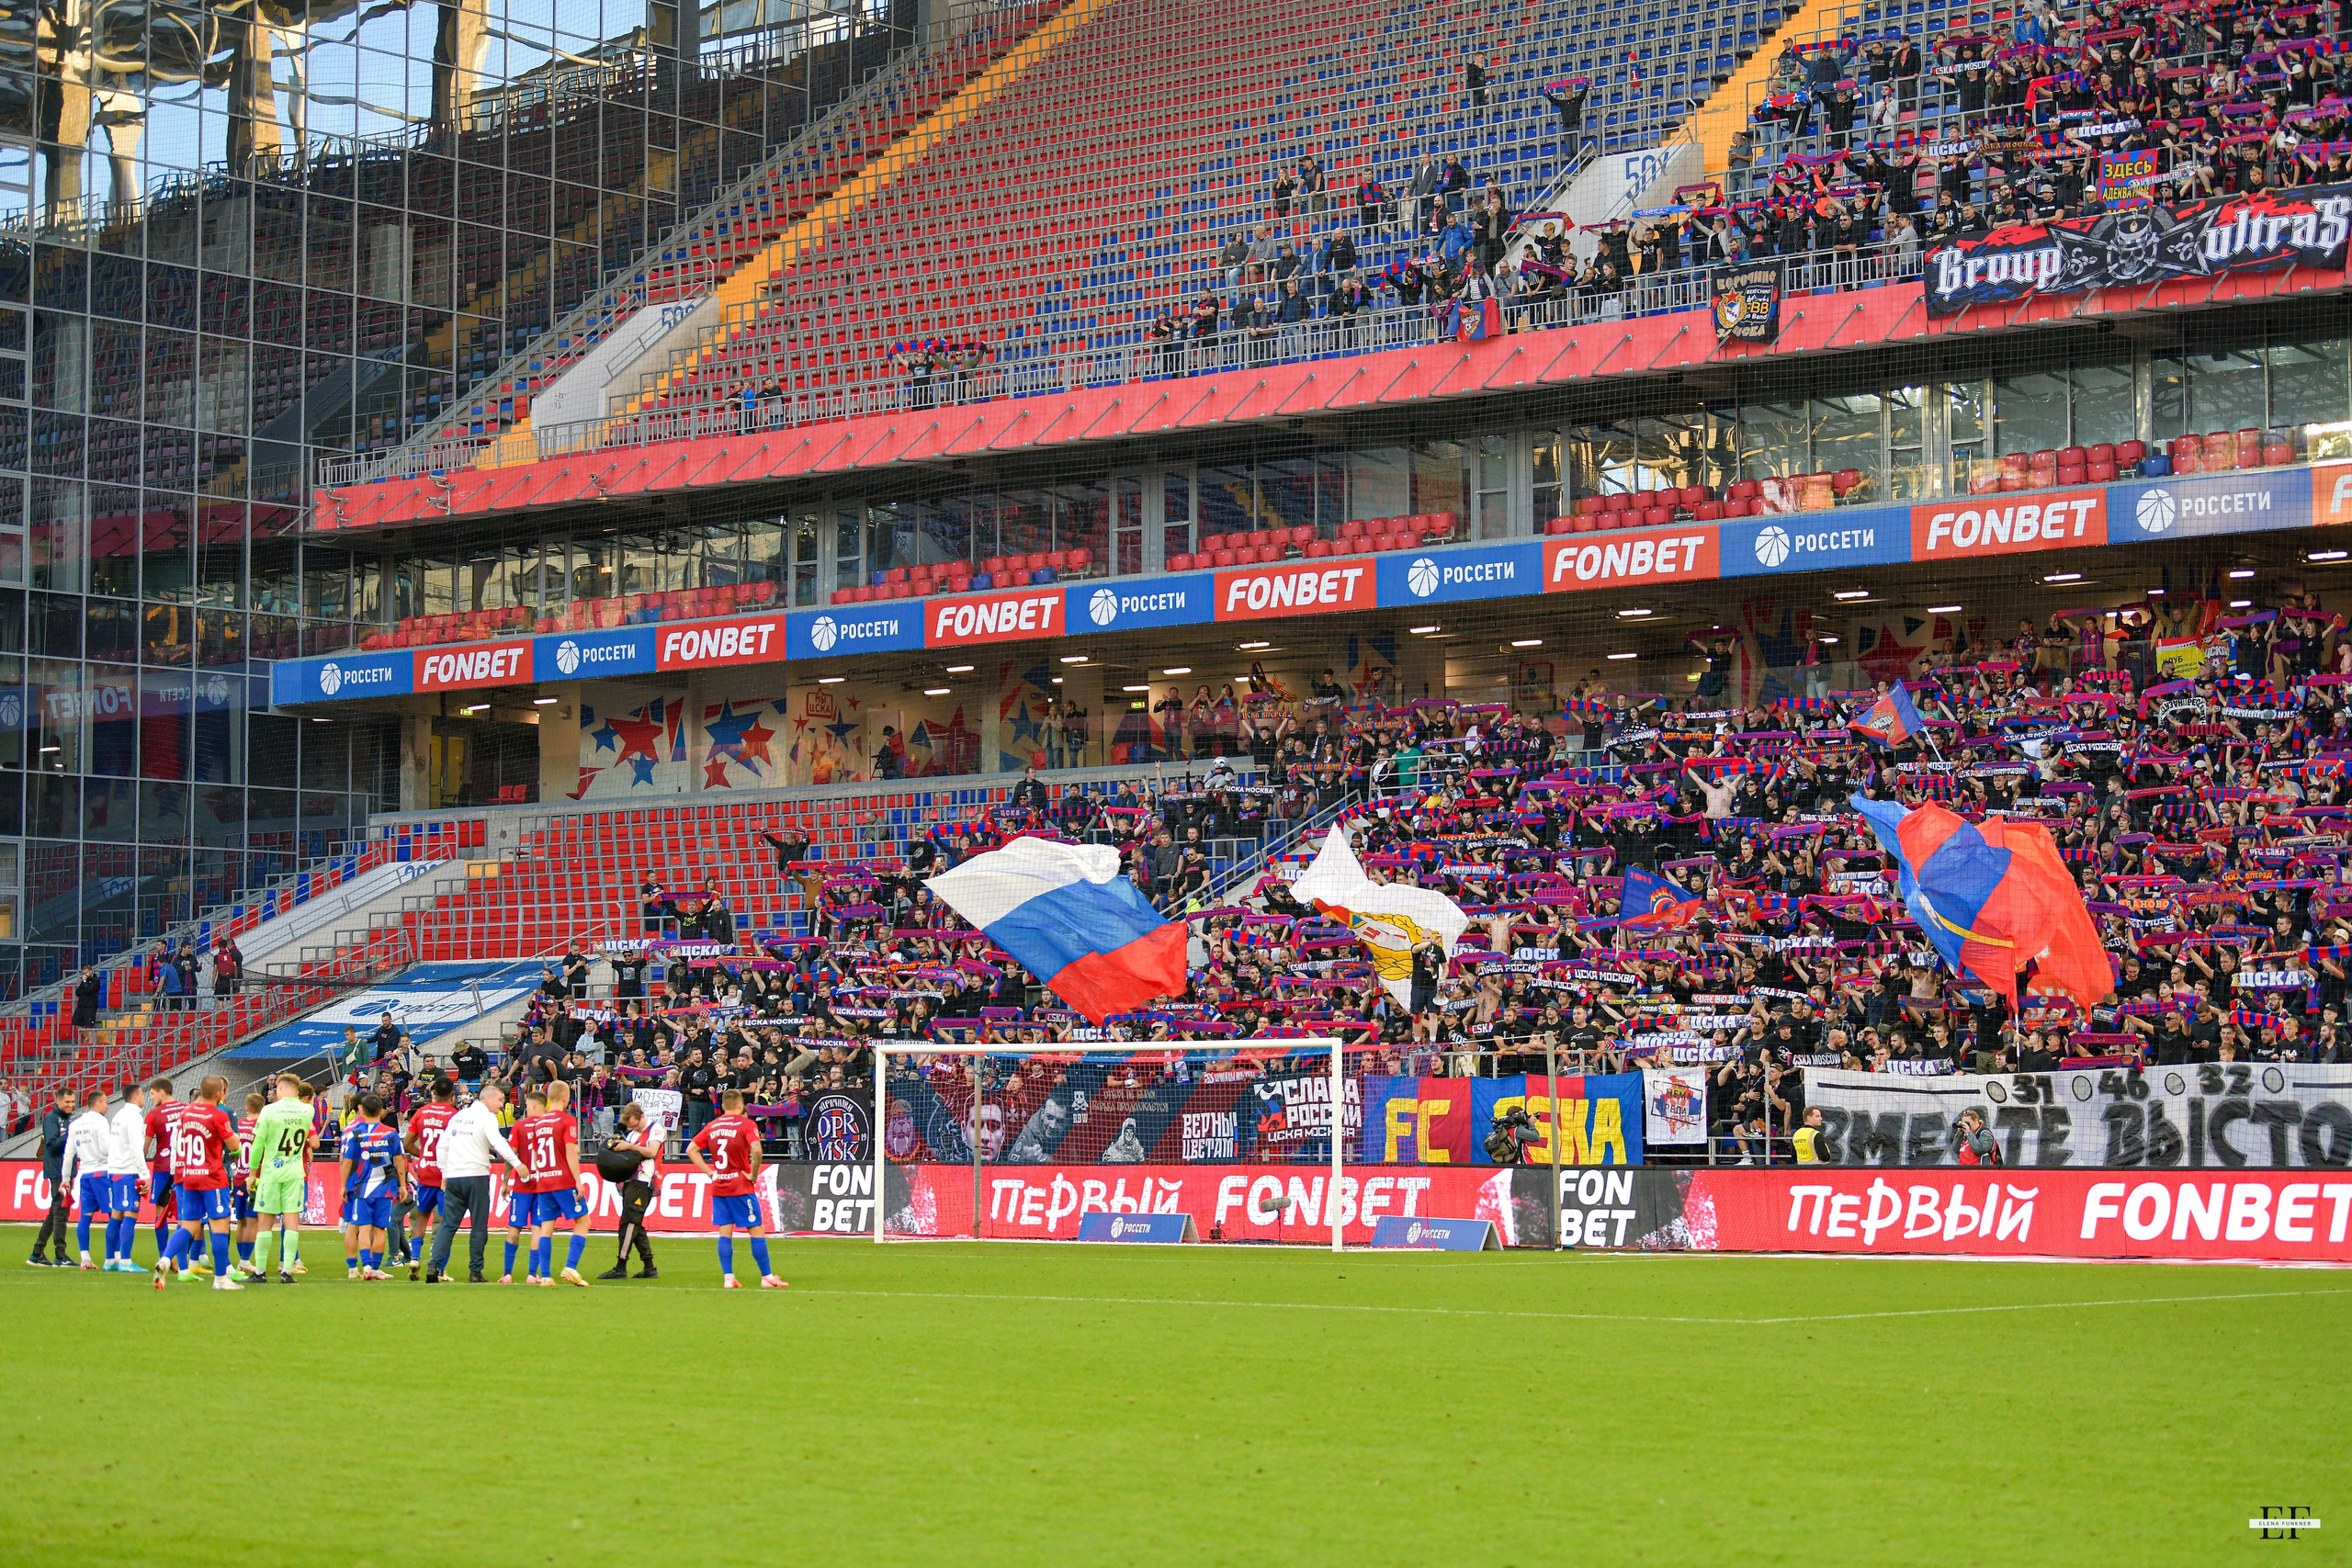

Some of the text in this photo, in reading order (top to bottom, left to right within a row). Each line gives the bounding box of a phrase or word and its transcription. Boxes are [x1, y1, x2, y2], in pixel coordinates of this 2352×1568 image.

[2076, 122, 2126, 138] ЦСКА
[1928, 141, 1968, 157] ЦСКА
[2104, 160, 2153, 179] ЗДЕСЬ
[2180, 491, 2272, 516] РОССЕТИ
[1927, 499, 2098, 550] FONBET
[1794, 529, 1875, 553] РОССЕТИ
[1553, 536, 1705, 582] FONBET
[1443, 561, 1515, 584] РОССЕТИ
[1227, 568, 1363, 612] FONBET
[1121, 592, 1185, 613] РОССЕТИ
[935, 598, 1058, 638] FONBET
[840, 620, 899, 640] РОССЕТИ
[582, 643, 636, 663] РОССЕТИ
[662, 624, 775, 662] FONBET
[345, 667, 392, 685] РОССЕТИ
[422, 648, 524, 684] FONBET
[1226, 785, 1274, 795] ЦСКА МОСКВА
[606, 939, 650, 951] ЦСКА
[680, 945, 719, 956] ЦСКА
[1575, 968, 1635, 985] ЦСКА МОСКВА
[2238, 971, 2299, 987] ЦСКА
[745, 1016, 804, 1026] ЦСКА МОСКВА
[837, 1007, 888, 1017] ЦСКА МОСКВА
[1691, 1015, 1736, 1029] ЦСКА
[816, 1038, 848, 1047] МОСКВА
[1673, 1046, 1725, 1062] ЦСКА
[1887, 1059, 1938, 1076] ЦСКА
[2012, 1063, 2254, 1104] 31 46 32
[818, 1112, 859, 1139] OPR
[1073, 1113, 1088, 1124] RBW
[278, 1128, 306, 1156] 49
[1385, 1098, 1451, 1163] FC
[185, 1134, 206, 1167] 19
[423, 1128, 445, 1157] 27
[537, 1136, 557, 1168] 31
[715, 1138, 729, 1169] 3
[811, 1165, 873, 1196] FON
[1560, 1169, 1634, 1206] FON
[991, 1172, 1183, 1233] ПЕРВЫЙ
[1788, 1178, 2352, 1246] ПЕРВЫЙ FONBET
[812, 1199, 876, 1232] BET
[1124, 1223, 1151, 1234] РОССЕТИ
[1421, 1228, 1451, 1240] РОССЕТИ
[1560, 1209, 1636, 1247] BET
